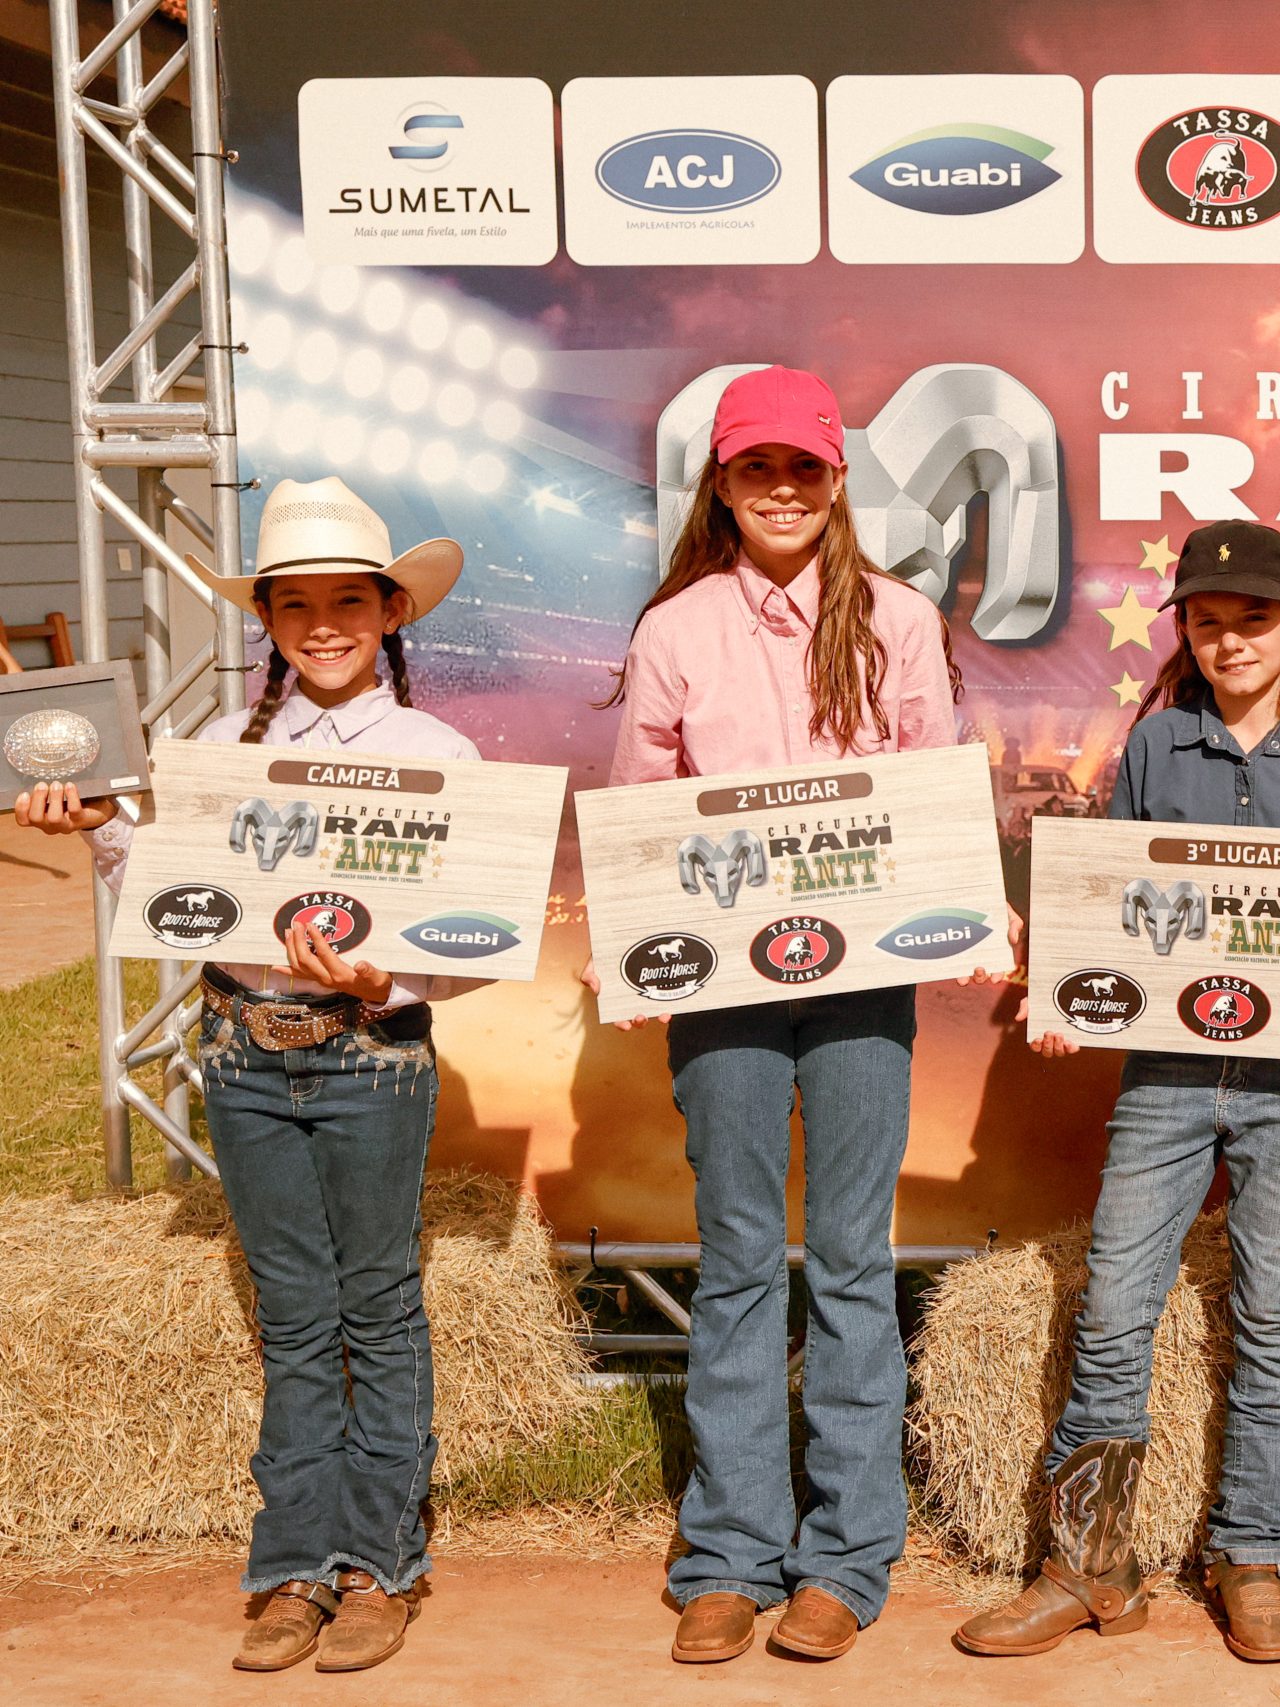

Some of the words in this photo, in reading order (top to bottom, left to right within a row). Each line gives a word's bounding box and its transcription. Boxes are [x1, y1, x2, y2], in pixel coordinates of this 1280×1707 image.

[1173, 108, 1269, 141] TASSA
[644, 154, 734, 189] ACJ
[883, 162, 1022, 188] Guabi
[329, 187, 530, 214] SUMETAL
[626, 220, 697, 230] IMPLEMENTOS
[1185, 206, 1259, 226] JEANS
[354, 226, 378, 237] Mais
[380, 228, 399, 239] que
[401, 228, 424, 237] uma
[426, 226, 457, 238] fivela,
[460, 228, 477, 236] um
[479, 226, 507, 237] Estilo
[735, 788, 757, 809] 2º
[764, 779, 840, 805] LUGAR
[328, 804, 451, 822] CIRCUITO
[323, 816, 449, 842] RAM
[768, 813, 890, 837] CIRCUITO
[769, 825, 892, 858] RAM
[333, 837, 429, 876] ANTT
[1186, 843, 1208, 861] 3º
[790, 847, 879, 894] ANTT
[299, 893, 354, 911] TASSA
[158, 912, 193, 927] BOOTS
[191, 913, 223, 928] HORSE
[767, 918, 822, 936] TASSA
[419, 927, 499, 946] Guabi
[894, 925, 972, 948] Guabi
[639, 966, 670, 983] BOOTS
[669, 962, 701, 979] HORSE
[780, 968, 822, 982] JEANS
[1198, 977, 1251, 995] TASSA
[1068, 997, 1100, 1013] BOOTS
[1098, 998, 1130, 1014] HORSE
[1203, 1026, 1243, 1039] JEANS
